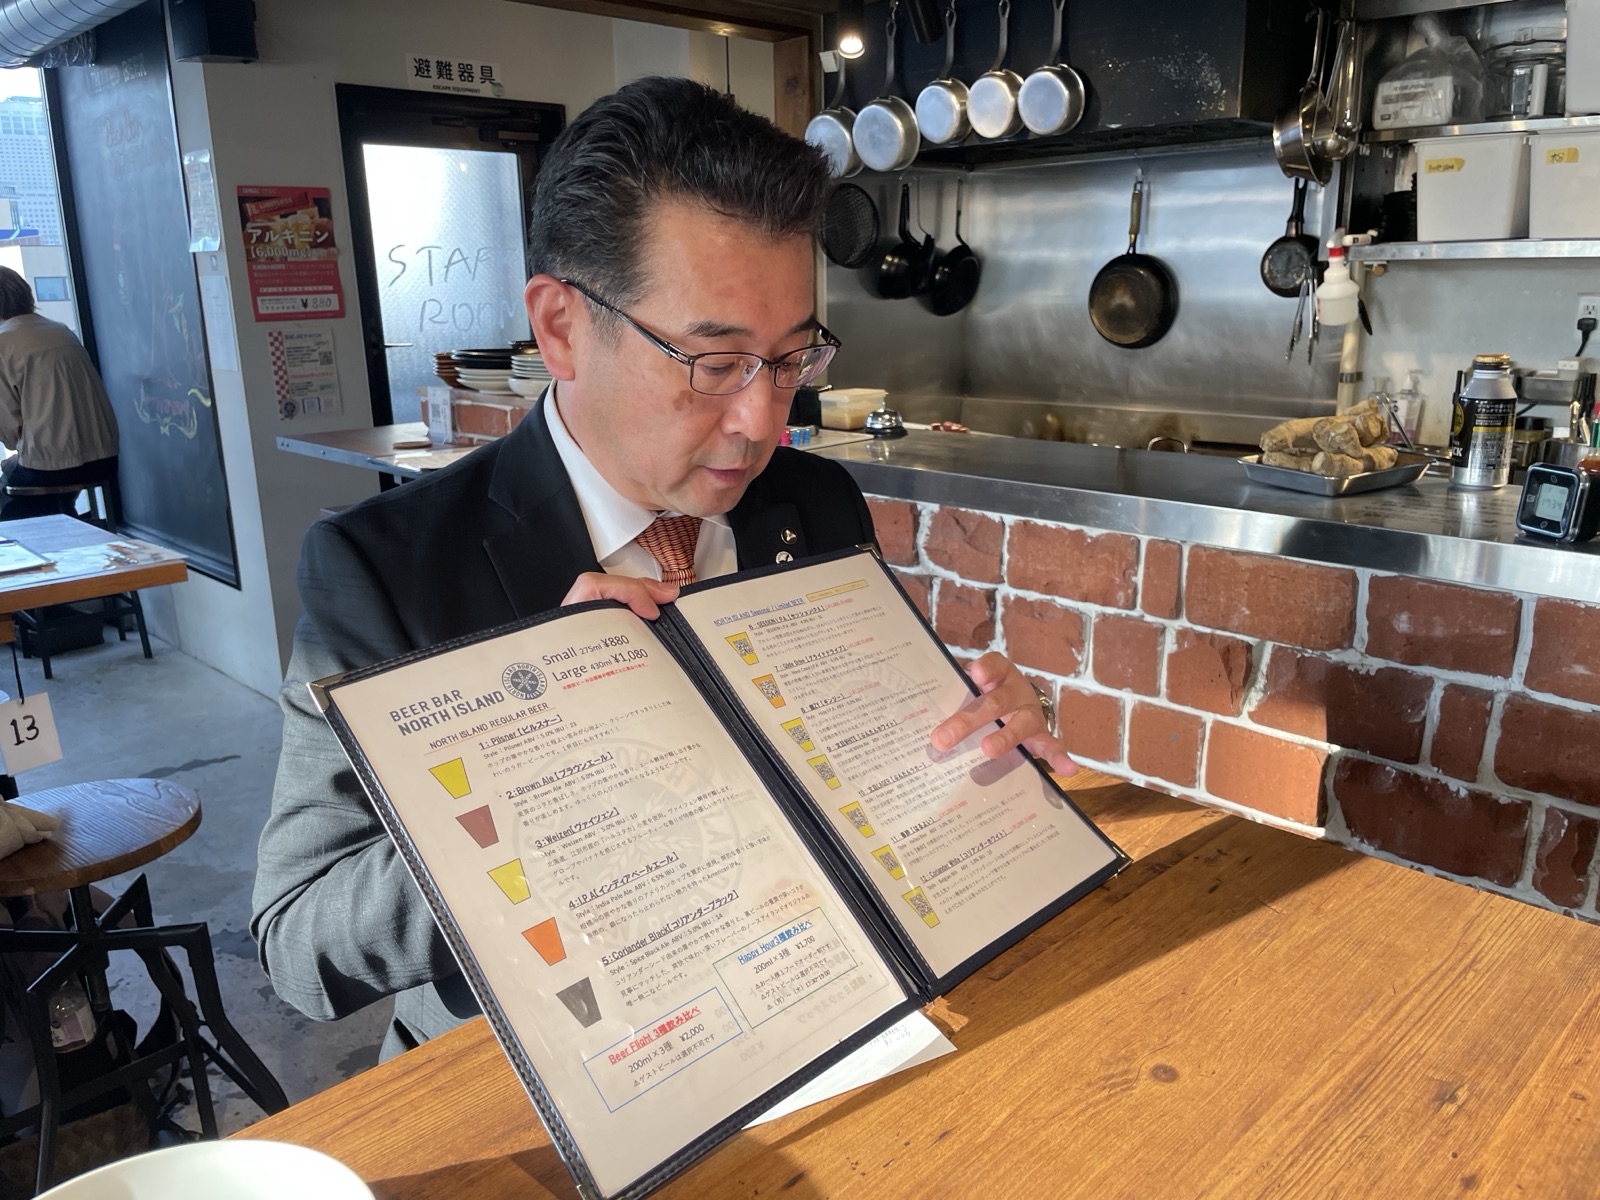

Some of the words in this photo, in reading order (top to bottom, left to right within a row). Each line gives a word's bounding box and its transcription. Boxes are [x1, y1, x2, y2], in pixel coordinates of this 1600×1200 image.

[414, 57, 496, 84] 避難器具
[540, 646, 578, 665] Small
[578, 643, 602, 654] 275ml
[600, 634, 630, 647] ¥880
[551, 665, 589, 681] Large
[588, 658, 613, 670] 430ml
[610, 648, 649, 663] ¥1,080
[388, 700, 430, 722] BEER
[430, 689, 463, 707] BAR
[397, 708, 451, 736] NORTH
[450, 690, 506, 717] ISLAND
[10, 714, 39, 746] 13
[428, 733, 459, 749] NORTH
[458, 723, 489, 738] ISLAND
[488, 709, 527, 727] REGULAR
[526, 702, 549, 714] BEER
[533, 788, 552, 799] Brown
[551, 784, 562, 792] Ale
[560, 836, 583, 849] Weizen
[600, 822, 615, 832] 5.0%
[594, 898, 610, 909] India
[609, 892, 623, 902] Pale
[622, 888, 633, 896] Ale
[629, 953, 645, 965] Spice
[643, 945, 660, 957] Black
[659, 940, 670, 949] Ale
[686, 923, 701, 934] 5.0%
[715, 912, 723, 920] 14
[794, 935, 815, 950] ¥1,700
[737, 947, 760, 964] Happy
[607, 1045, 630, 1064] Beer
[628, 1031, 653, 1051] Flight
[678, 1022, 705, 1043] ¥2,000
